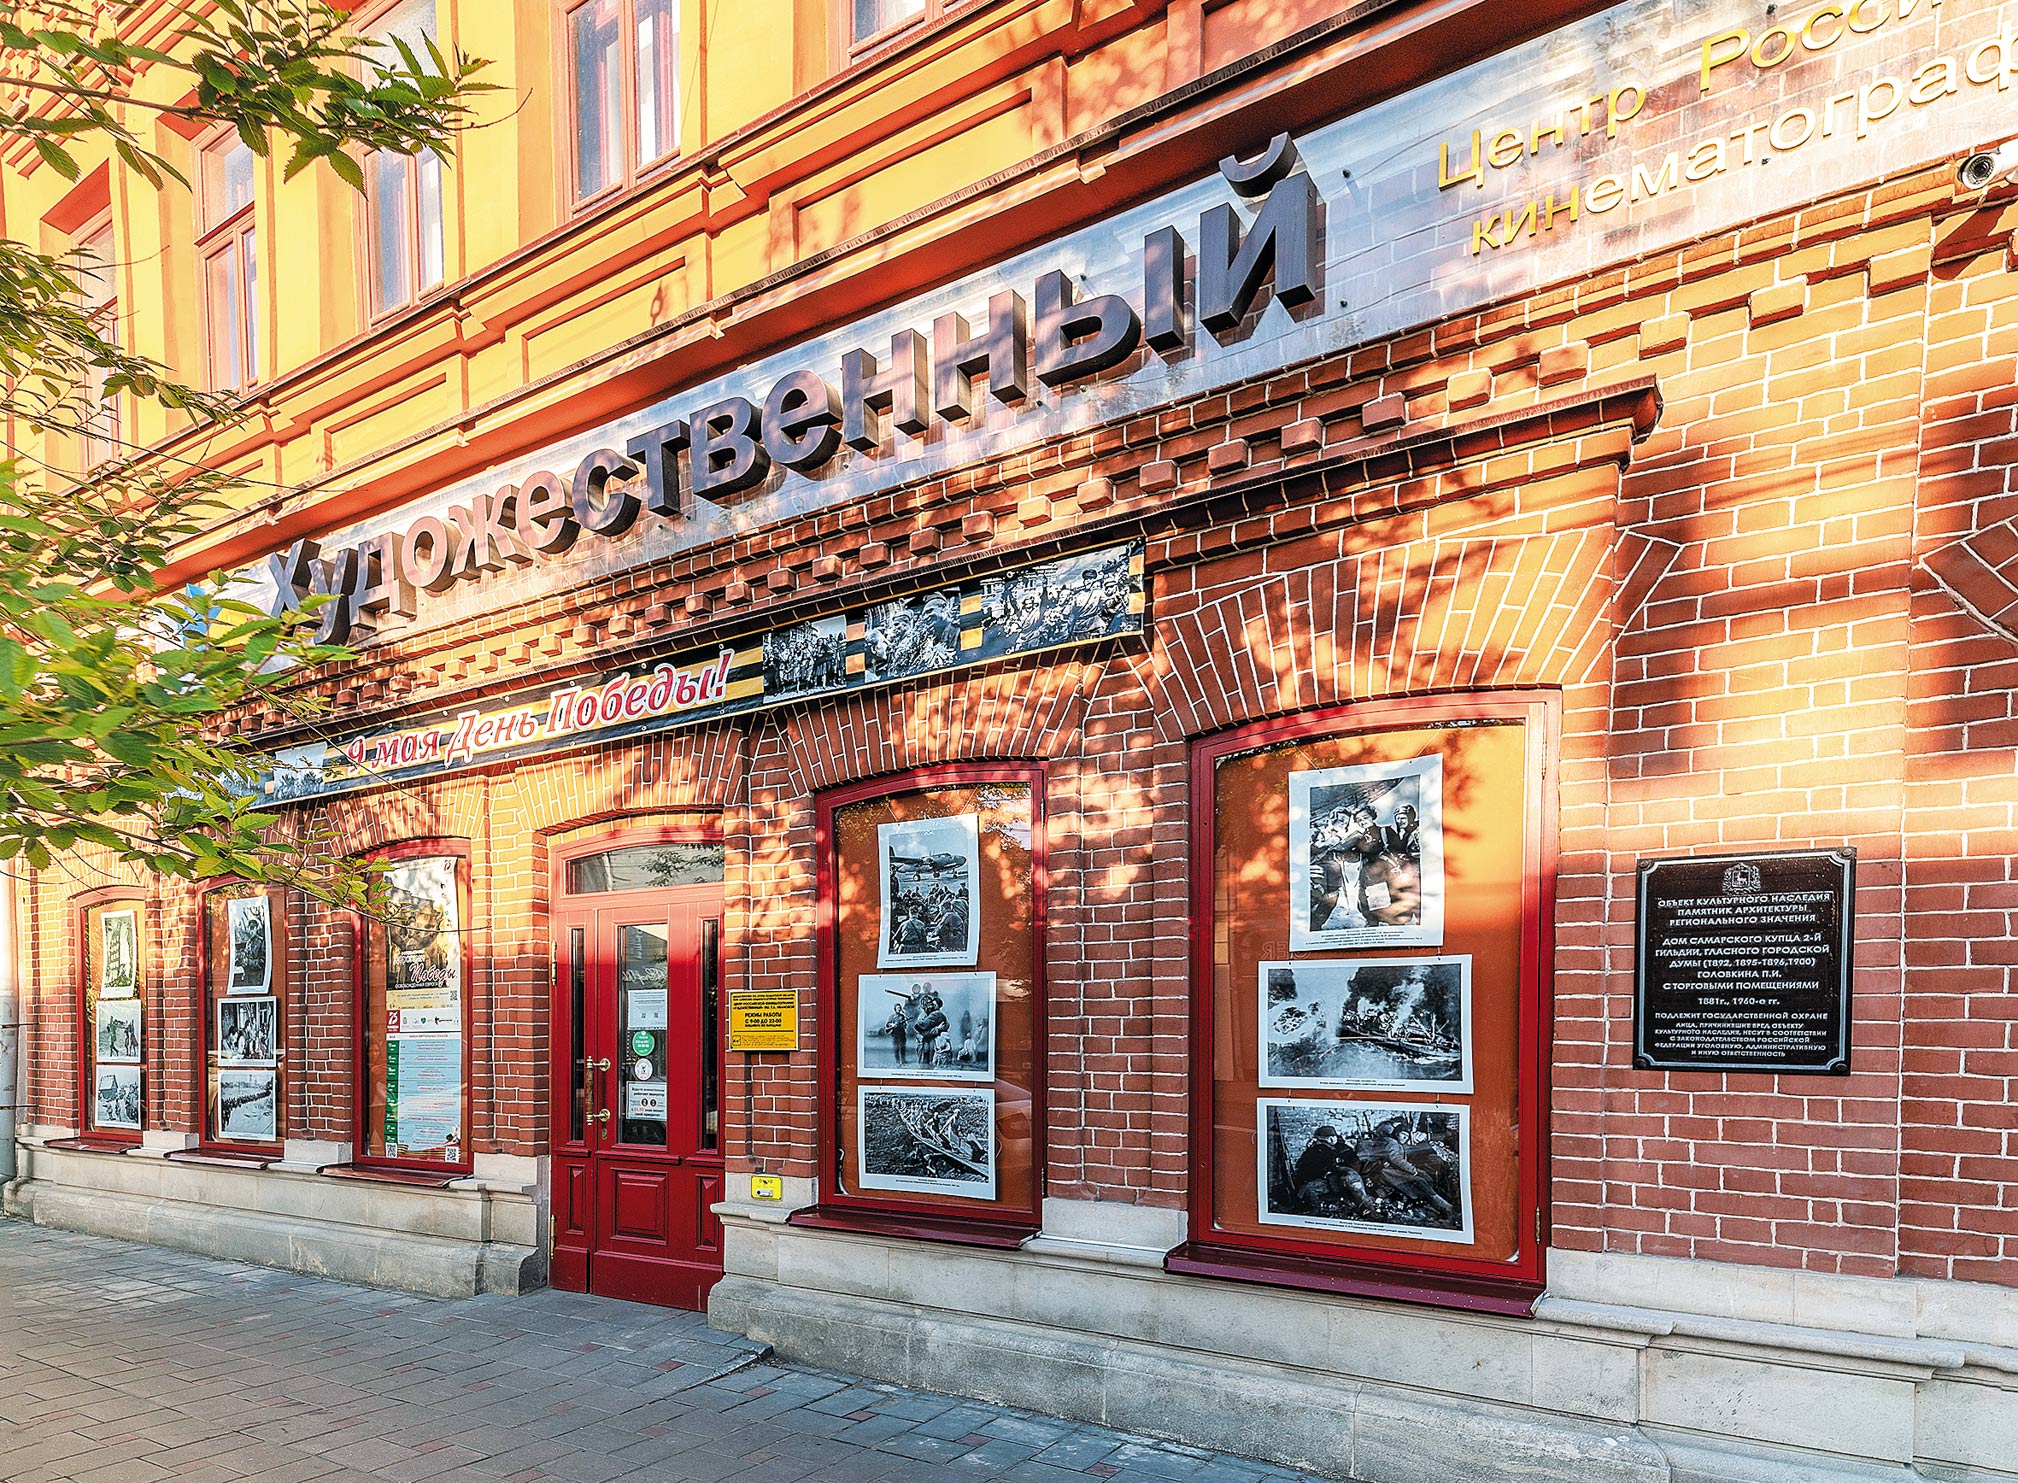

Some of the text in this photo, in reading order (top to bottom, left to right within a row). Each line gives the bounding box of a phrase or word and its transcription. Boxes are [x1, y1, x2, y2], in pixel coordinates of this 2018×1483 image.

[1438, 80, 1647, 191] Центр
[1472, 18, 2018, 256] кинематограф
[265, 132, 1327, 645] Художественный
[347, 650, 734, 774] 9 мая День Победы!
[1658, 894, 1830, 907] ОБЪЕКТ КУЛЬТУРНОГО НАСЛЕДИЯ
[1678, 905, 1808, 916] ПАМЯТНИК АРХИТЕКТУРЫ
[1670, 914, 1816, 926] РЕГИОНАЛЬНОГО ЗНАЧЕНИЯ
[1662, 933, 1822, 946] ДОМ САМАРСКОГО КУПЦА 2-Й
[1656, 944, 1830, 957] ГИЛЬДИИ, ГЛАСНОГО ГОРОДСКОЙ
[1669, 960, 1701, 968] ДУМЫ
[1703, 960, 1732, 968] (1892,
[409, 962, 457, 987] Победы
[1697, 970, 1782, 978] ГОЛОВКИНА П.И.
[1672, 982, 1733, 990] ТОРГОВЫМИ
[1736, 981, 1819, 990] ПОМЕЩЕНИЯМИ
[1702, 1012, 1788, 1020] ГОСУДАРСТВЕННОЙ
